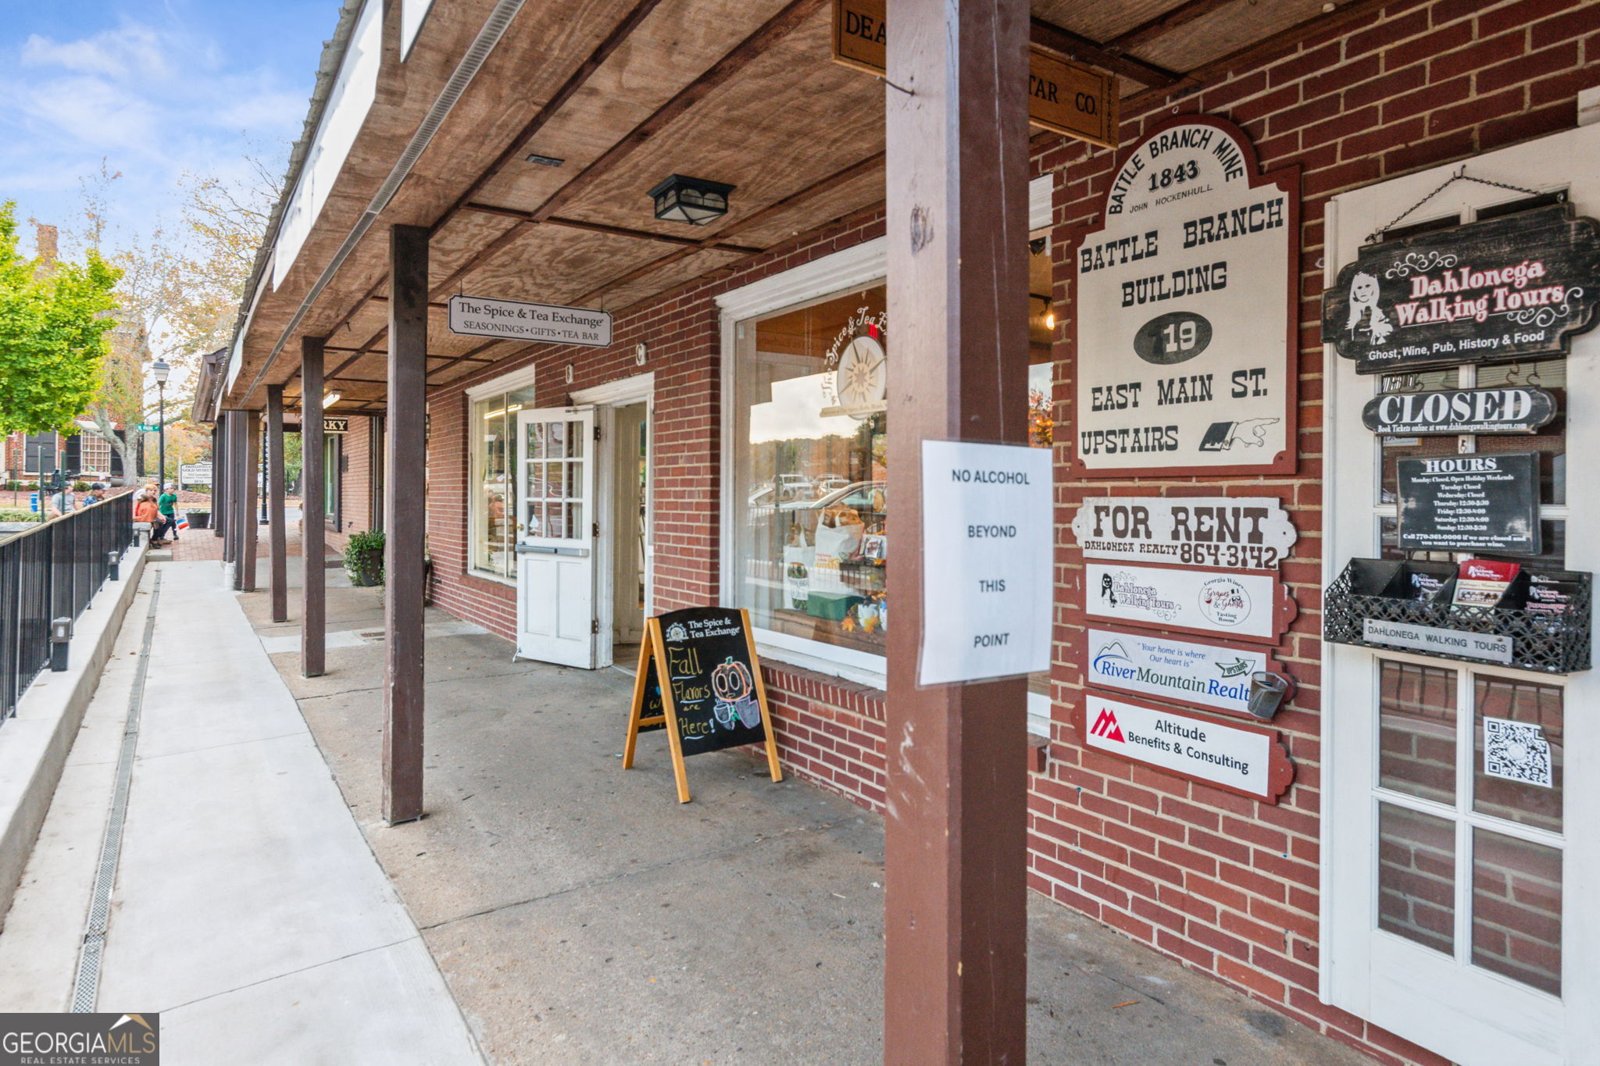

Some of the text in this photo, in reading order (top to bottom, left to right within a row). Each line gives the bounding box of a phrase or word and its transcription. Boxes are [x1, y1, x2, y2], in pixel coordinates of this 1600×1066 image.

[1076, 92, 1097, 116] CO.
[1109, 128, 1243, 214] BATTLE BRANCH MINE
[1148, 160, 1200, 191] 1843
[1129, 184, 1213, 214] JOHN HOCKENHULL
[1080, 198, 1284, 273] BATTLE BRANCH
[1122, 262, 1227, 307] BUILDING
[1409, 261, 1545, 300] Dahlonega
[459, 301, 604, 328] The Spice & Tea Exchange
[1395, 285, 1564, 326] Walking Tours
[464, 321, 599, 341] SEASONINGS GIFTS TEA BAR
[1162, 321, 1197, 353] 19
[1368, 331, 1545, 361] Ghost, Wine, Pub, History & Food
[1091, 368, 1268, 412] EAST MAIN ST.
[1378, 389, 1532, 424] CLOSED
[1081, 425, 1179, 455] UPSTAIRS
[952, 469, 1030, 485] NO ALCOHOL
[1426, 458, 1497, 473] HOURS
[968, 525, 1017, 538] BEYOND
[1093, 505, 1269, 544] FOR RENT
[1084, 541, 1278, 570] DAHLONEGA REALTY 864-3142
[979, 579, 1005, 593] THIS
[1113, 581, 1157, 597] Dahlonega
[688, 617, 731, 629] The Spice &
[690, 630, 704, 638] Tea
[705, 626, 740, 636] Exchange
[973, 633, 1010, 648] POINT
[1158, 645, 1176, 655] home
[1185, 650, 1205, 659] where
[1368, 626, 1507, 653] DAHLONEGA WALKING TOURS
[668, 647, 703, 676] Fall
[1150, 654, 1162, 663] Our
[1164, 657, 1182, 665] heart
[1226, 660, 1248, 675] UPSTAIRS
[672, 682, 711, 701] Flavors
[683, 704, 701, 712] are
[1155, 719, 1206, 743] Altitude
[1128, 732, 1249, 775] Benefits & Consulting
